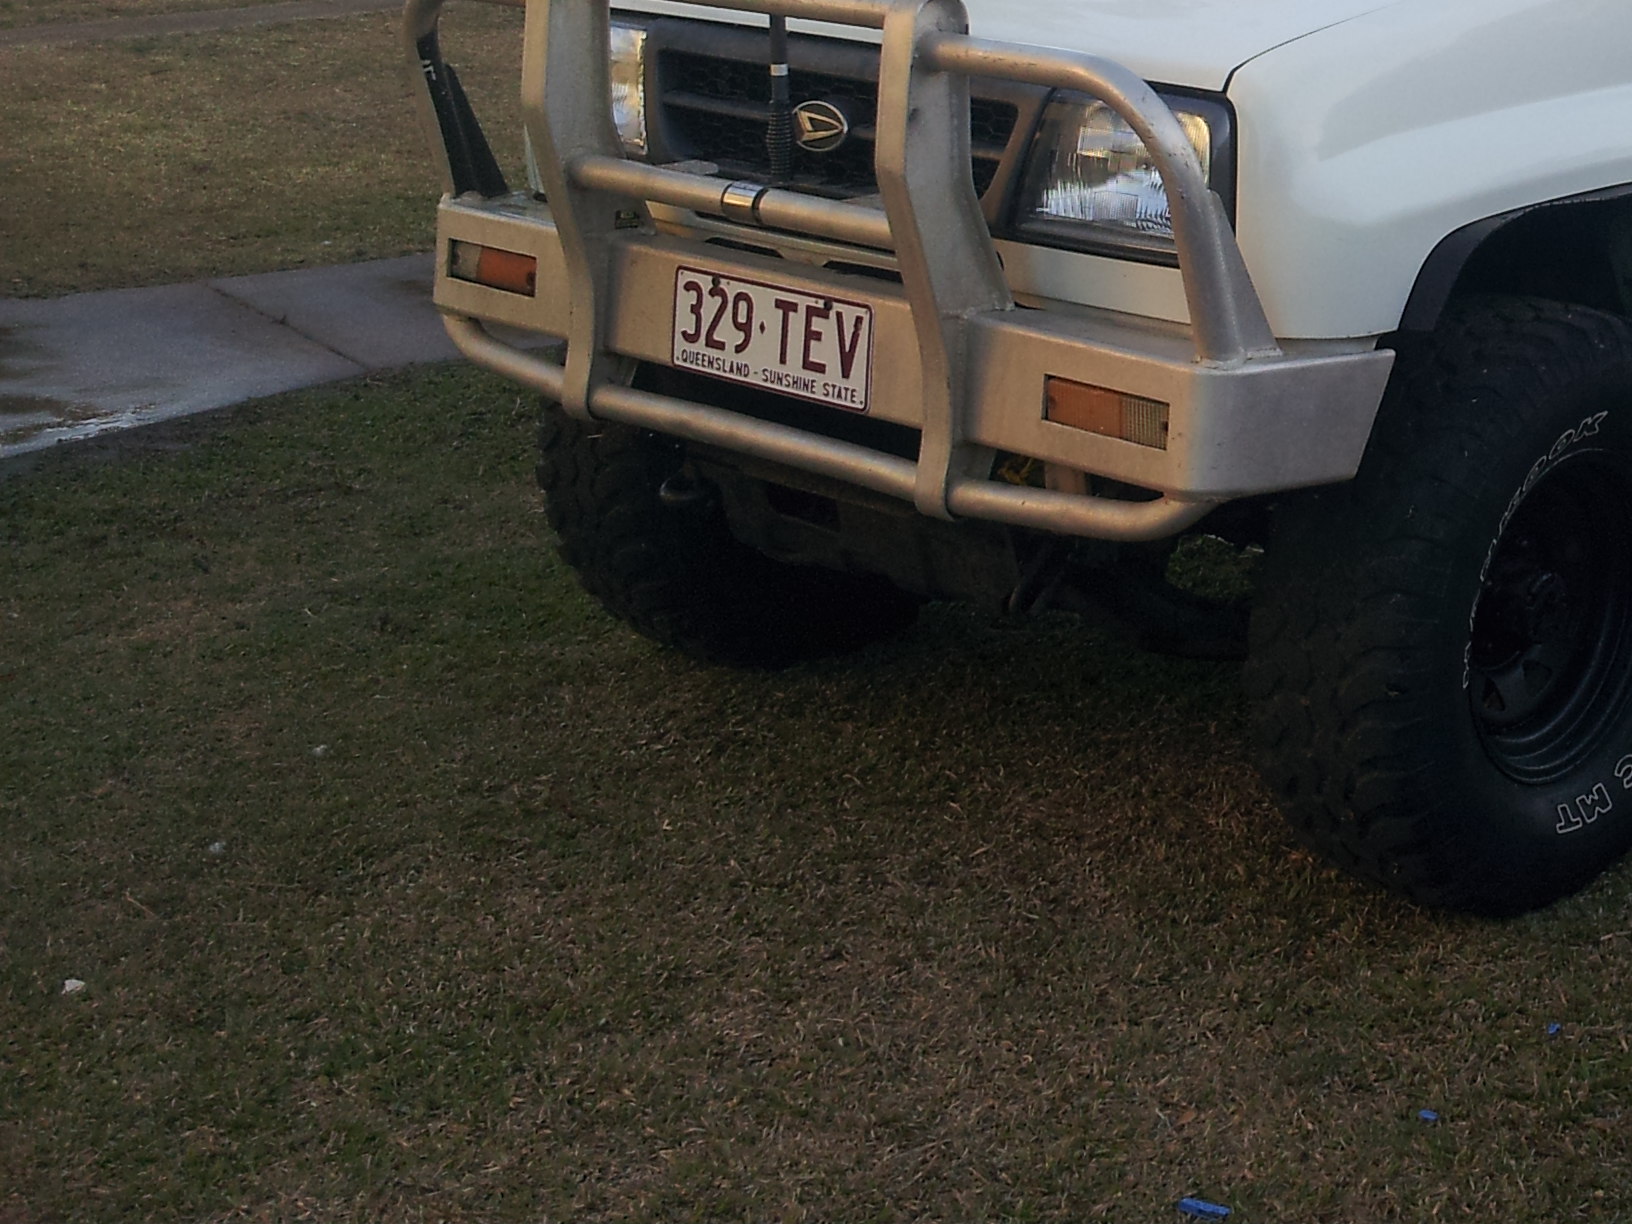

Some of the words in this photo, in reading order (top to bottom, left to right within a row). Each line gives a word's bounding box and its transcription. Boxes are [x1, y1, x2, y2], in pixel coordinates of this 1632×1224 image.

[681, 348, 750, 378] QUEENSLAND
[762, 368, 816, 395] SUNSHINE
[823, 382, 858, 405] STATE
[1556, 782, 1612, 834] MT
